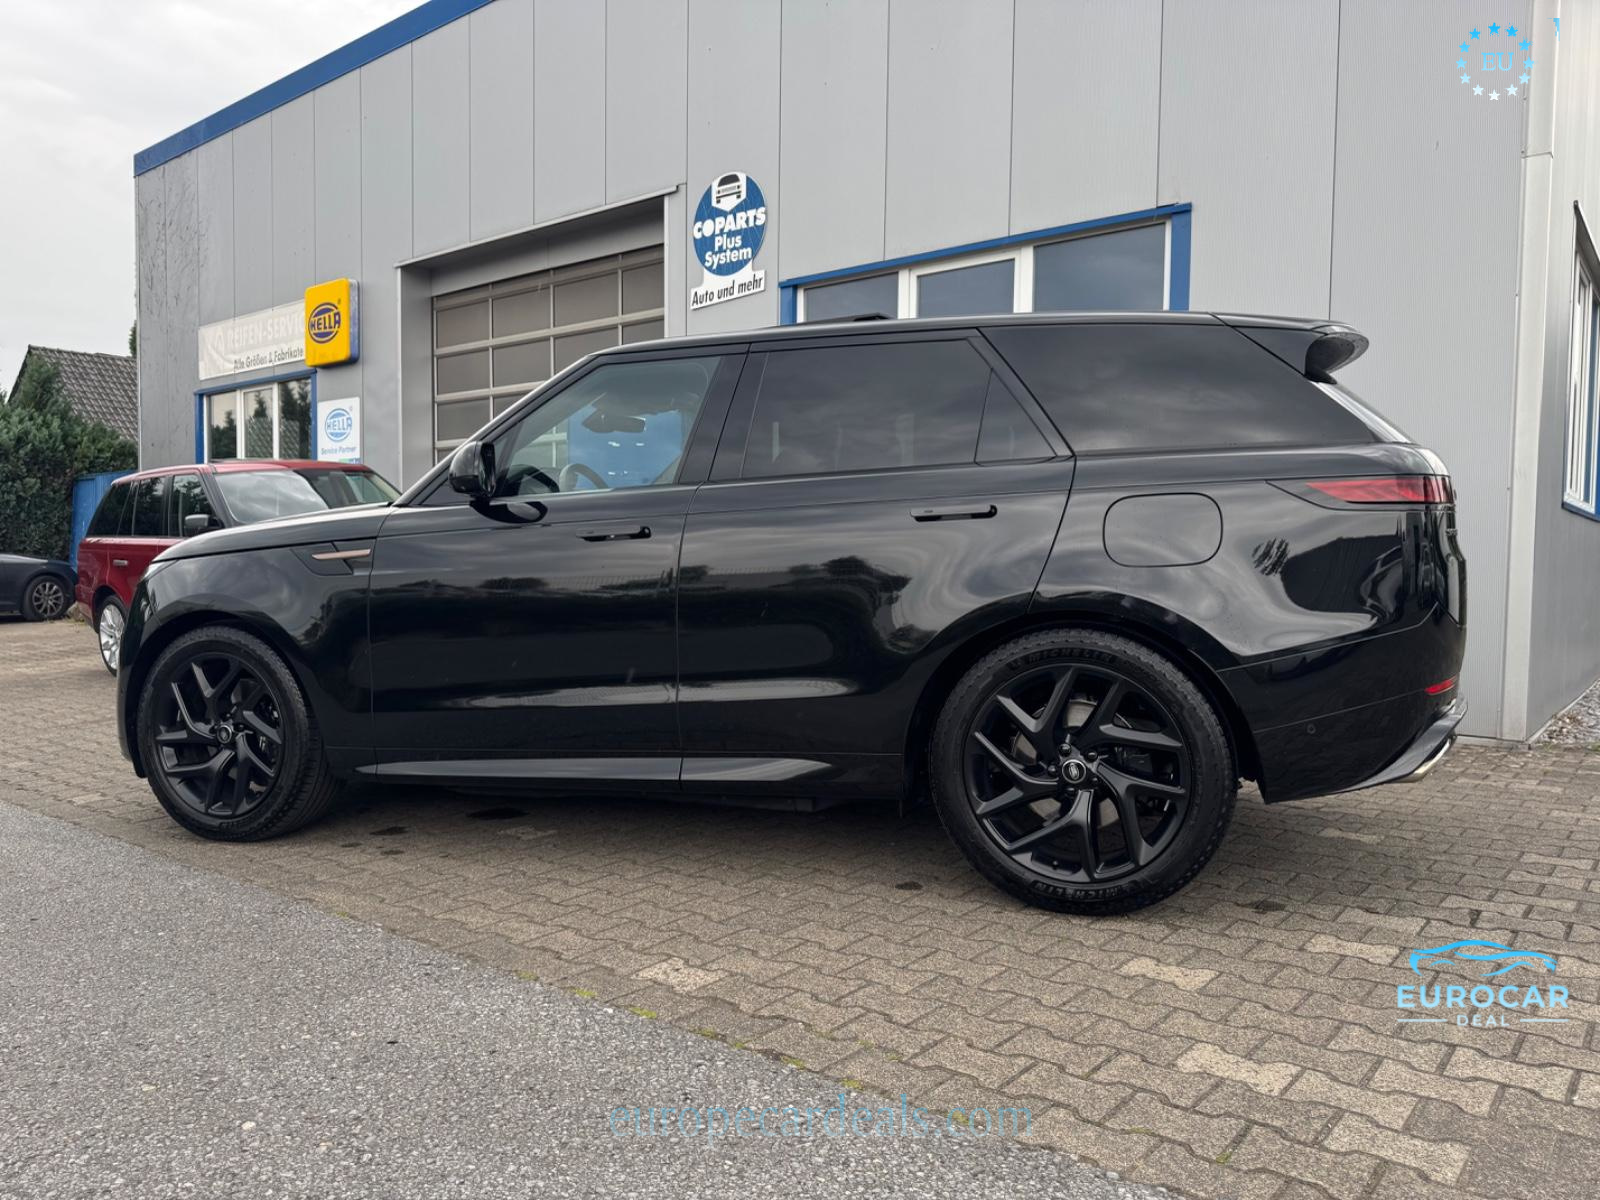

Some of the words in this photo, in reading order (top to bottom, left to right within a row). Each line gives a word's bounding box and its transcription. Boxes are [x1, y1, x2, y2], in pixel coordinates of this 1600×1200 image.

[693, 207, 766, 239] COPARTS
[714, 234, 742, 251] Plus
[704, 247, 752, 269] System
[691, 291, 715, 306] Auto
[717, 280, 735, 299] und
[737, 274, 763, 293] mehr
[227, 311, 305, 348] REIFEN-SERVIC
[310, 311, 341, 332] HELLA
[326, 416, 352, 431] HELLA
